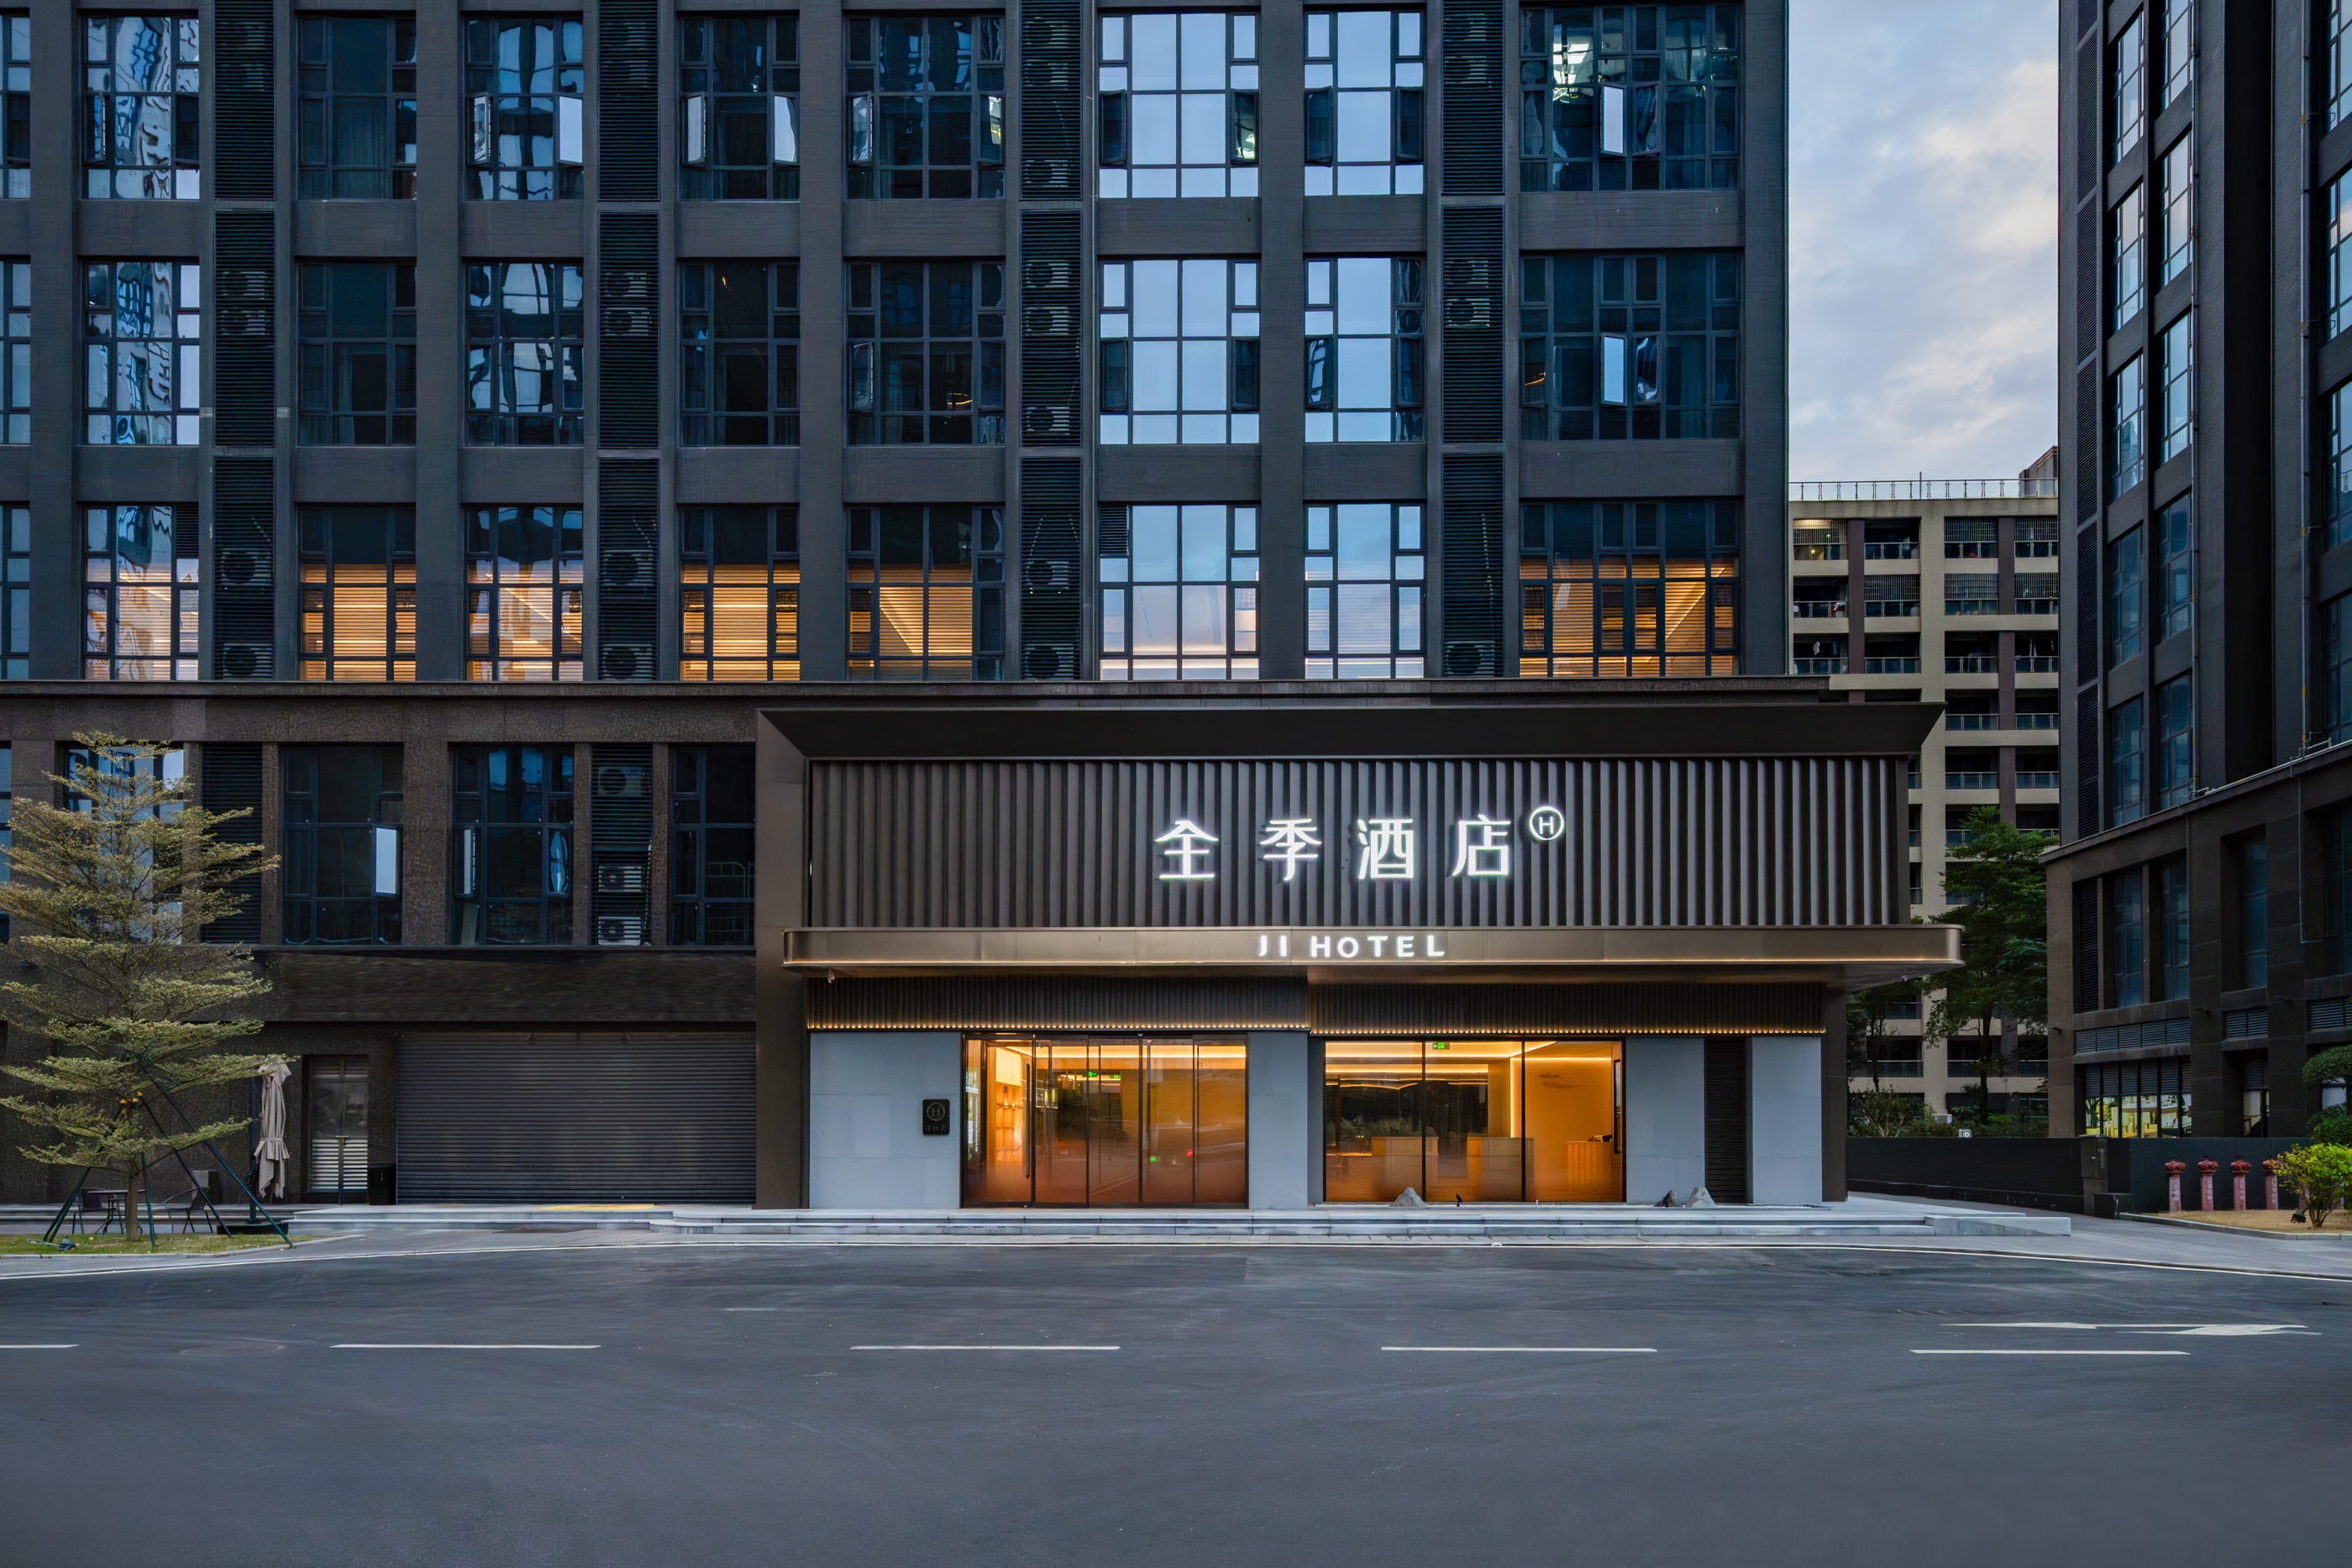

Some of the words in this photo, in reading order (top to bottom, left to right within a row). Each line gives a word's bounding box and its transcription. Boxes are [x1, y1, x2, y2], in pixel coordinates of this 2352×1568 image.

[1154, 814, 1511, 881] 全季酒店
[1257, 933, 1289, 958] JI
[1310, 934, 1446, 959] HOTEL
